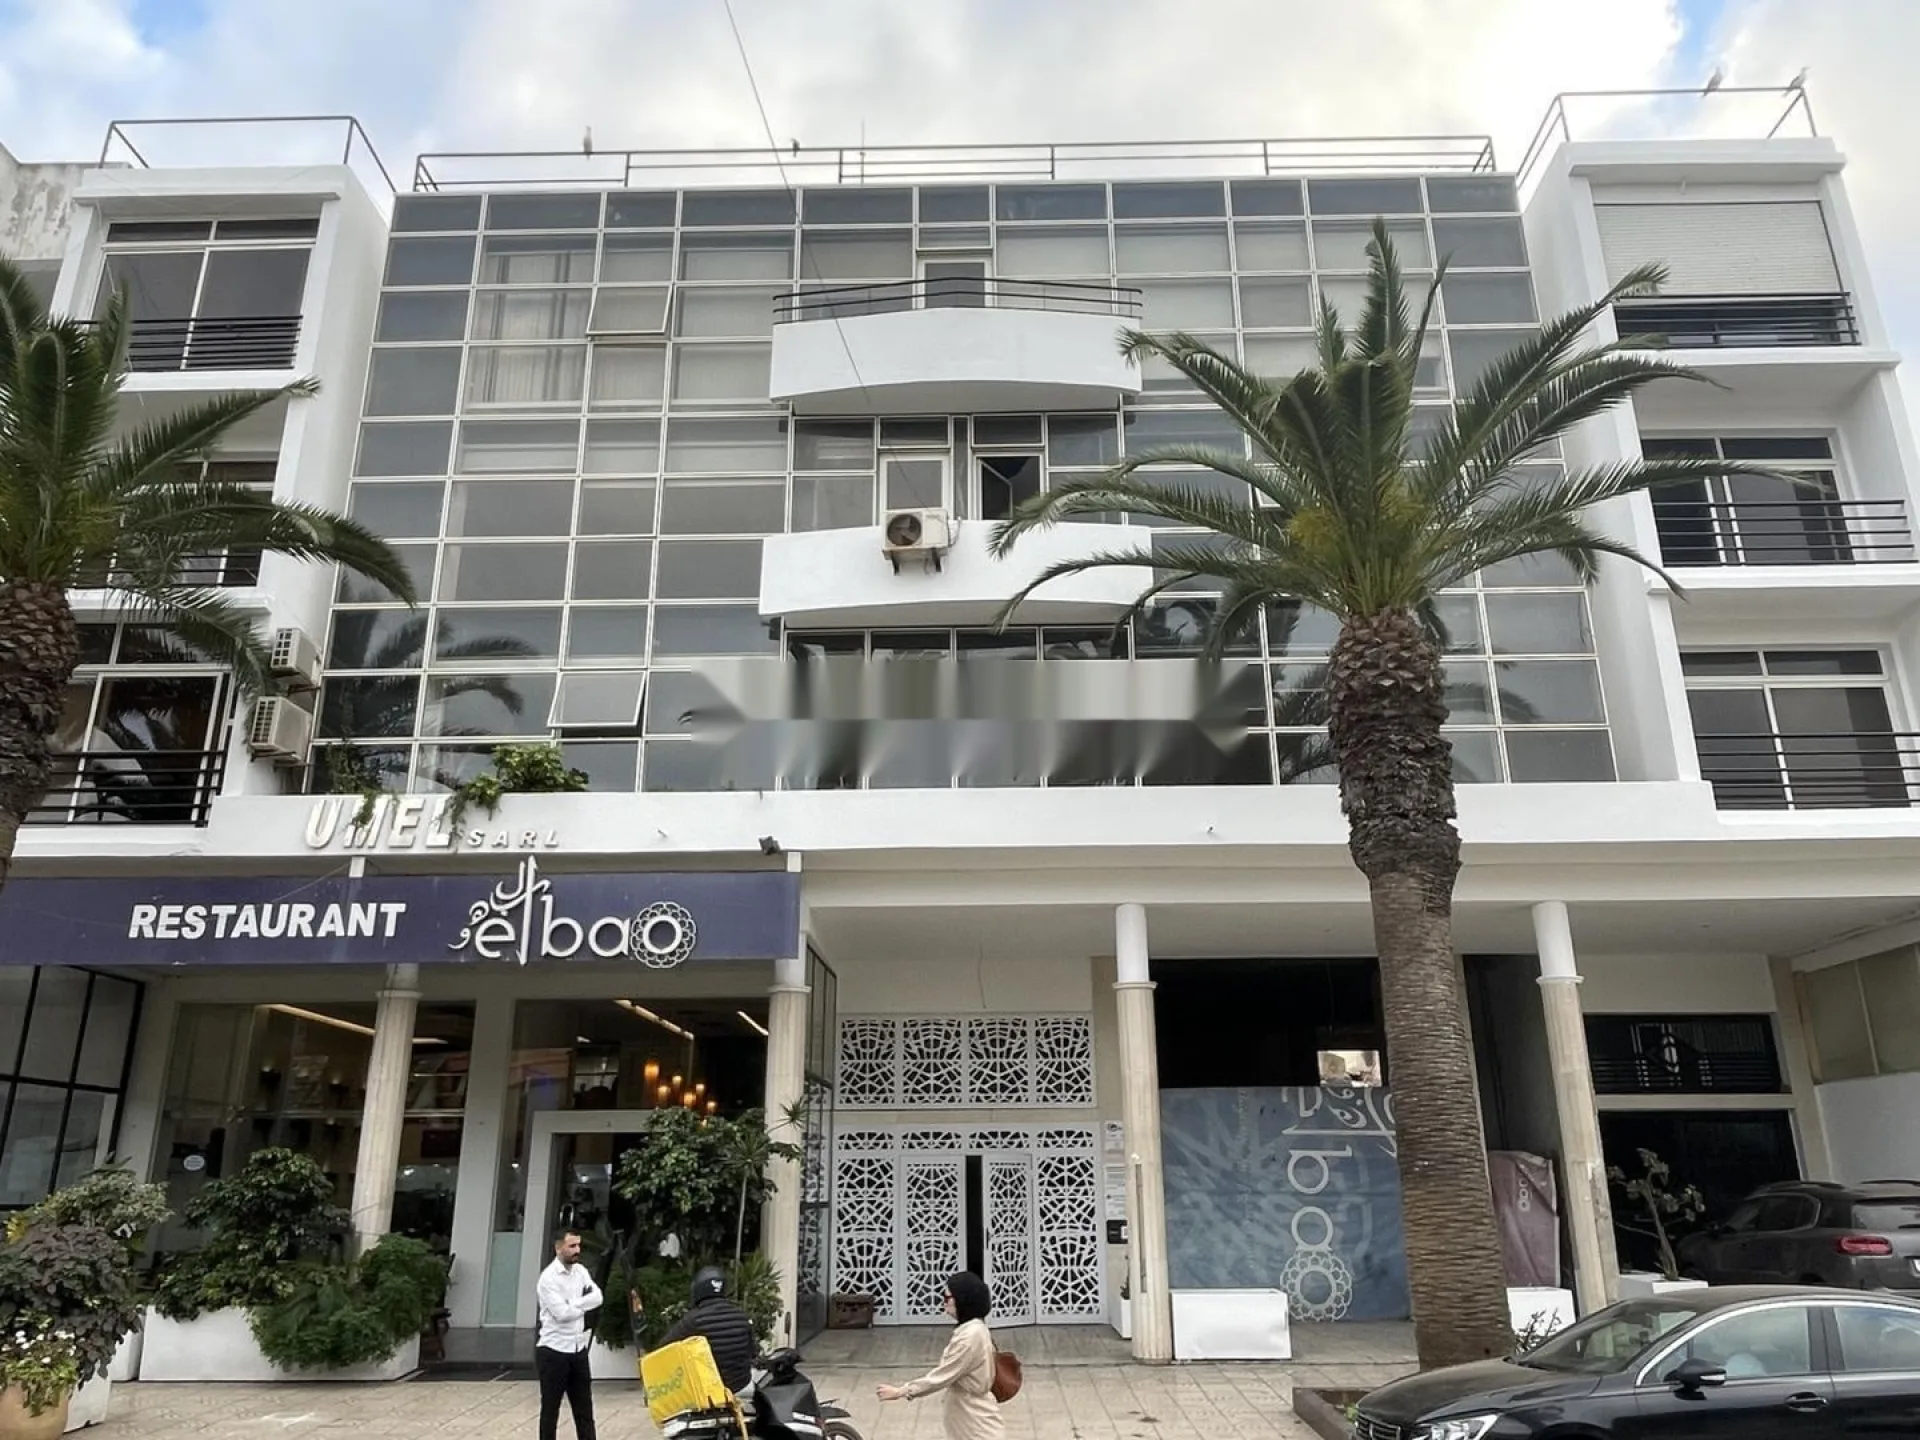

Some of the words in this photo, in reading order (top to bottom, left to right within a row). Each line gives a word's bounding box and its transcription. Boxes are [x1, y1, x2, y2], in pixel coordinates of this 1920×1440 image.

[305, 796, 452, 849] UMEL
[467, 828, 558, 848] SARL
[128, 903, 406, 939] RESTAURANT
